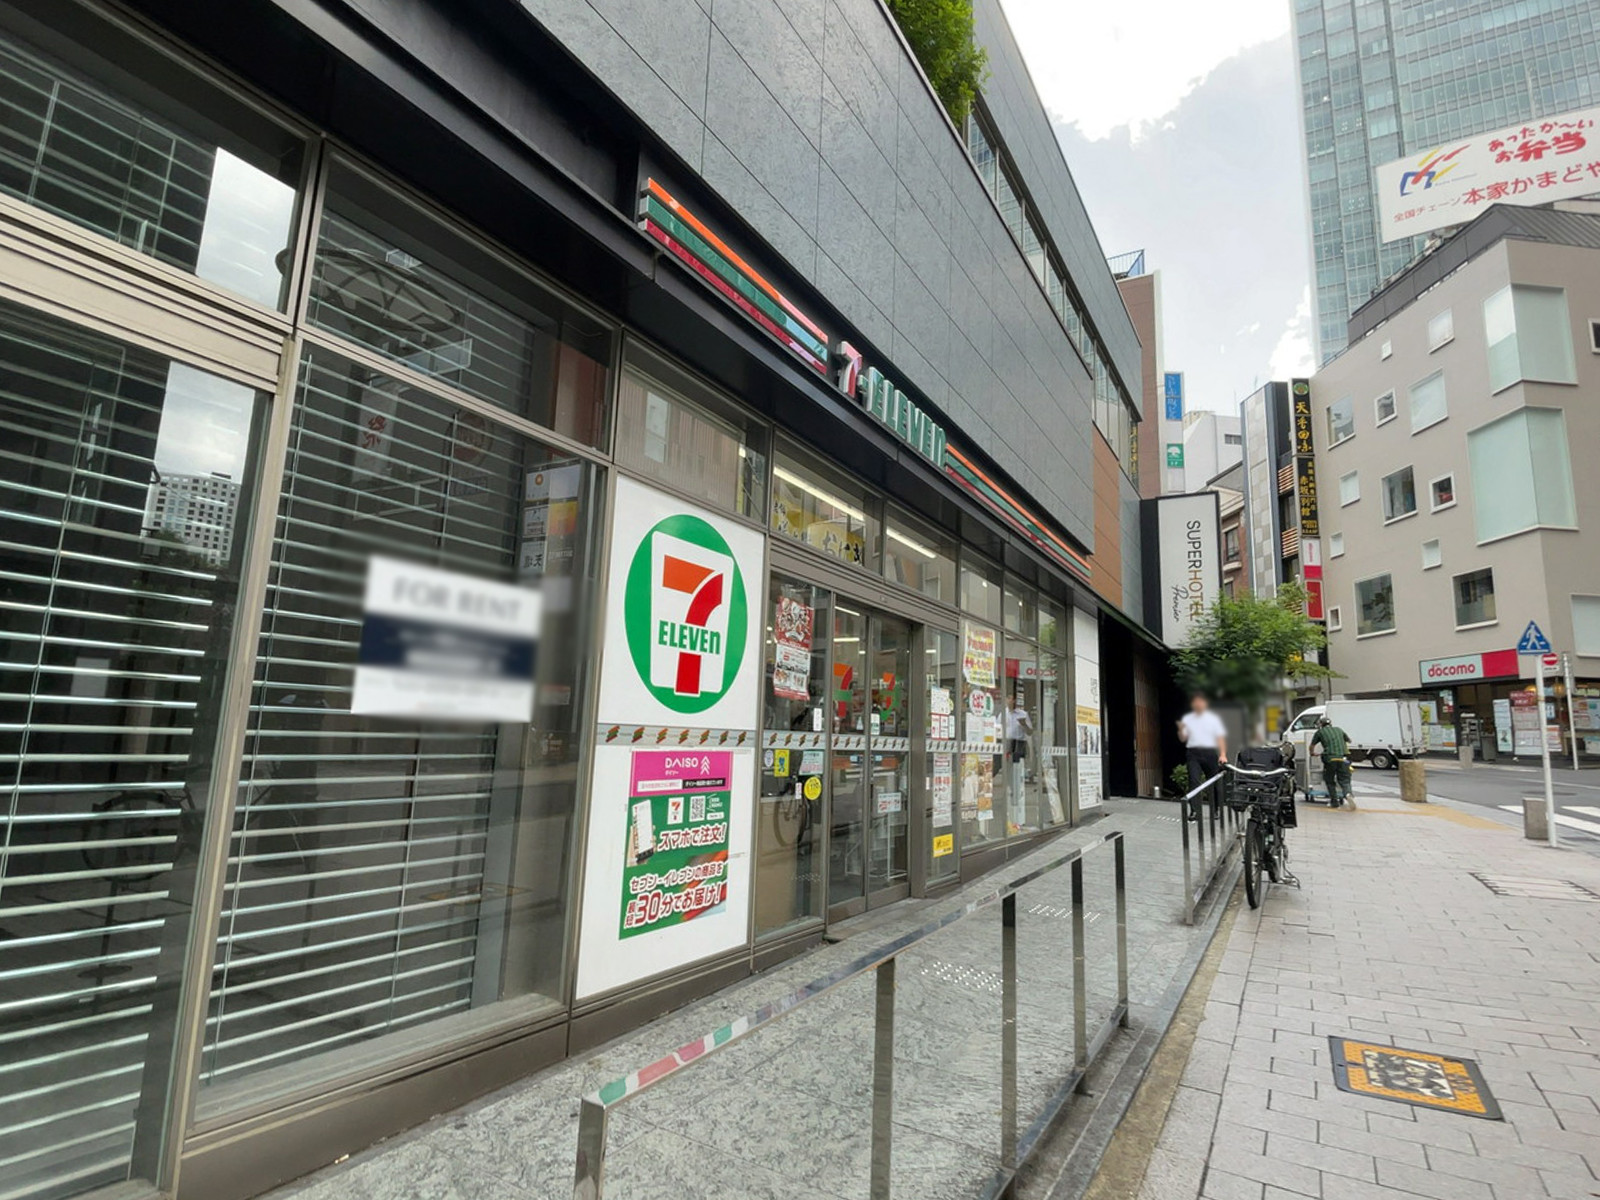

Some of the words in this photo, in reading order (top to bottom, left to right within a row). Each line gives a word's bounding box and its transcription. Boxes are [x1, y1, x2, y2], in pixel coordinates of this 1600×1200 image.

[1495, 131, 1586, 163] お弁当
[1393, 196, 1462, 222] 全国チェーン
[1428, 663, 1476, 678] docomo
[665, 757, 699, 768] DAISO
